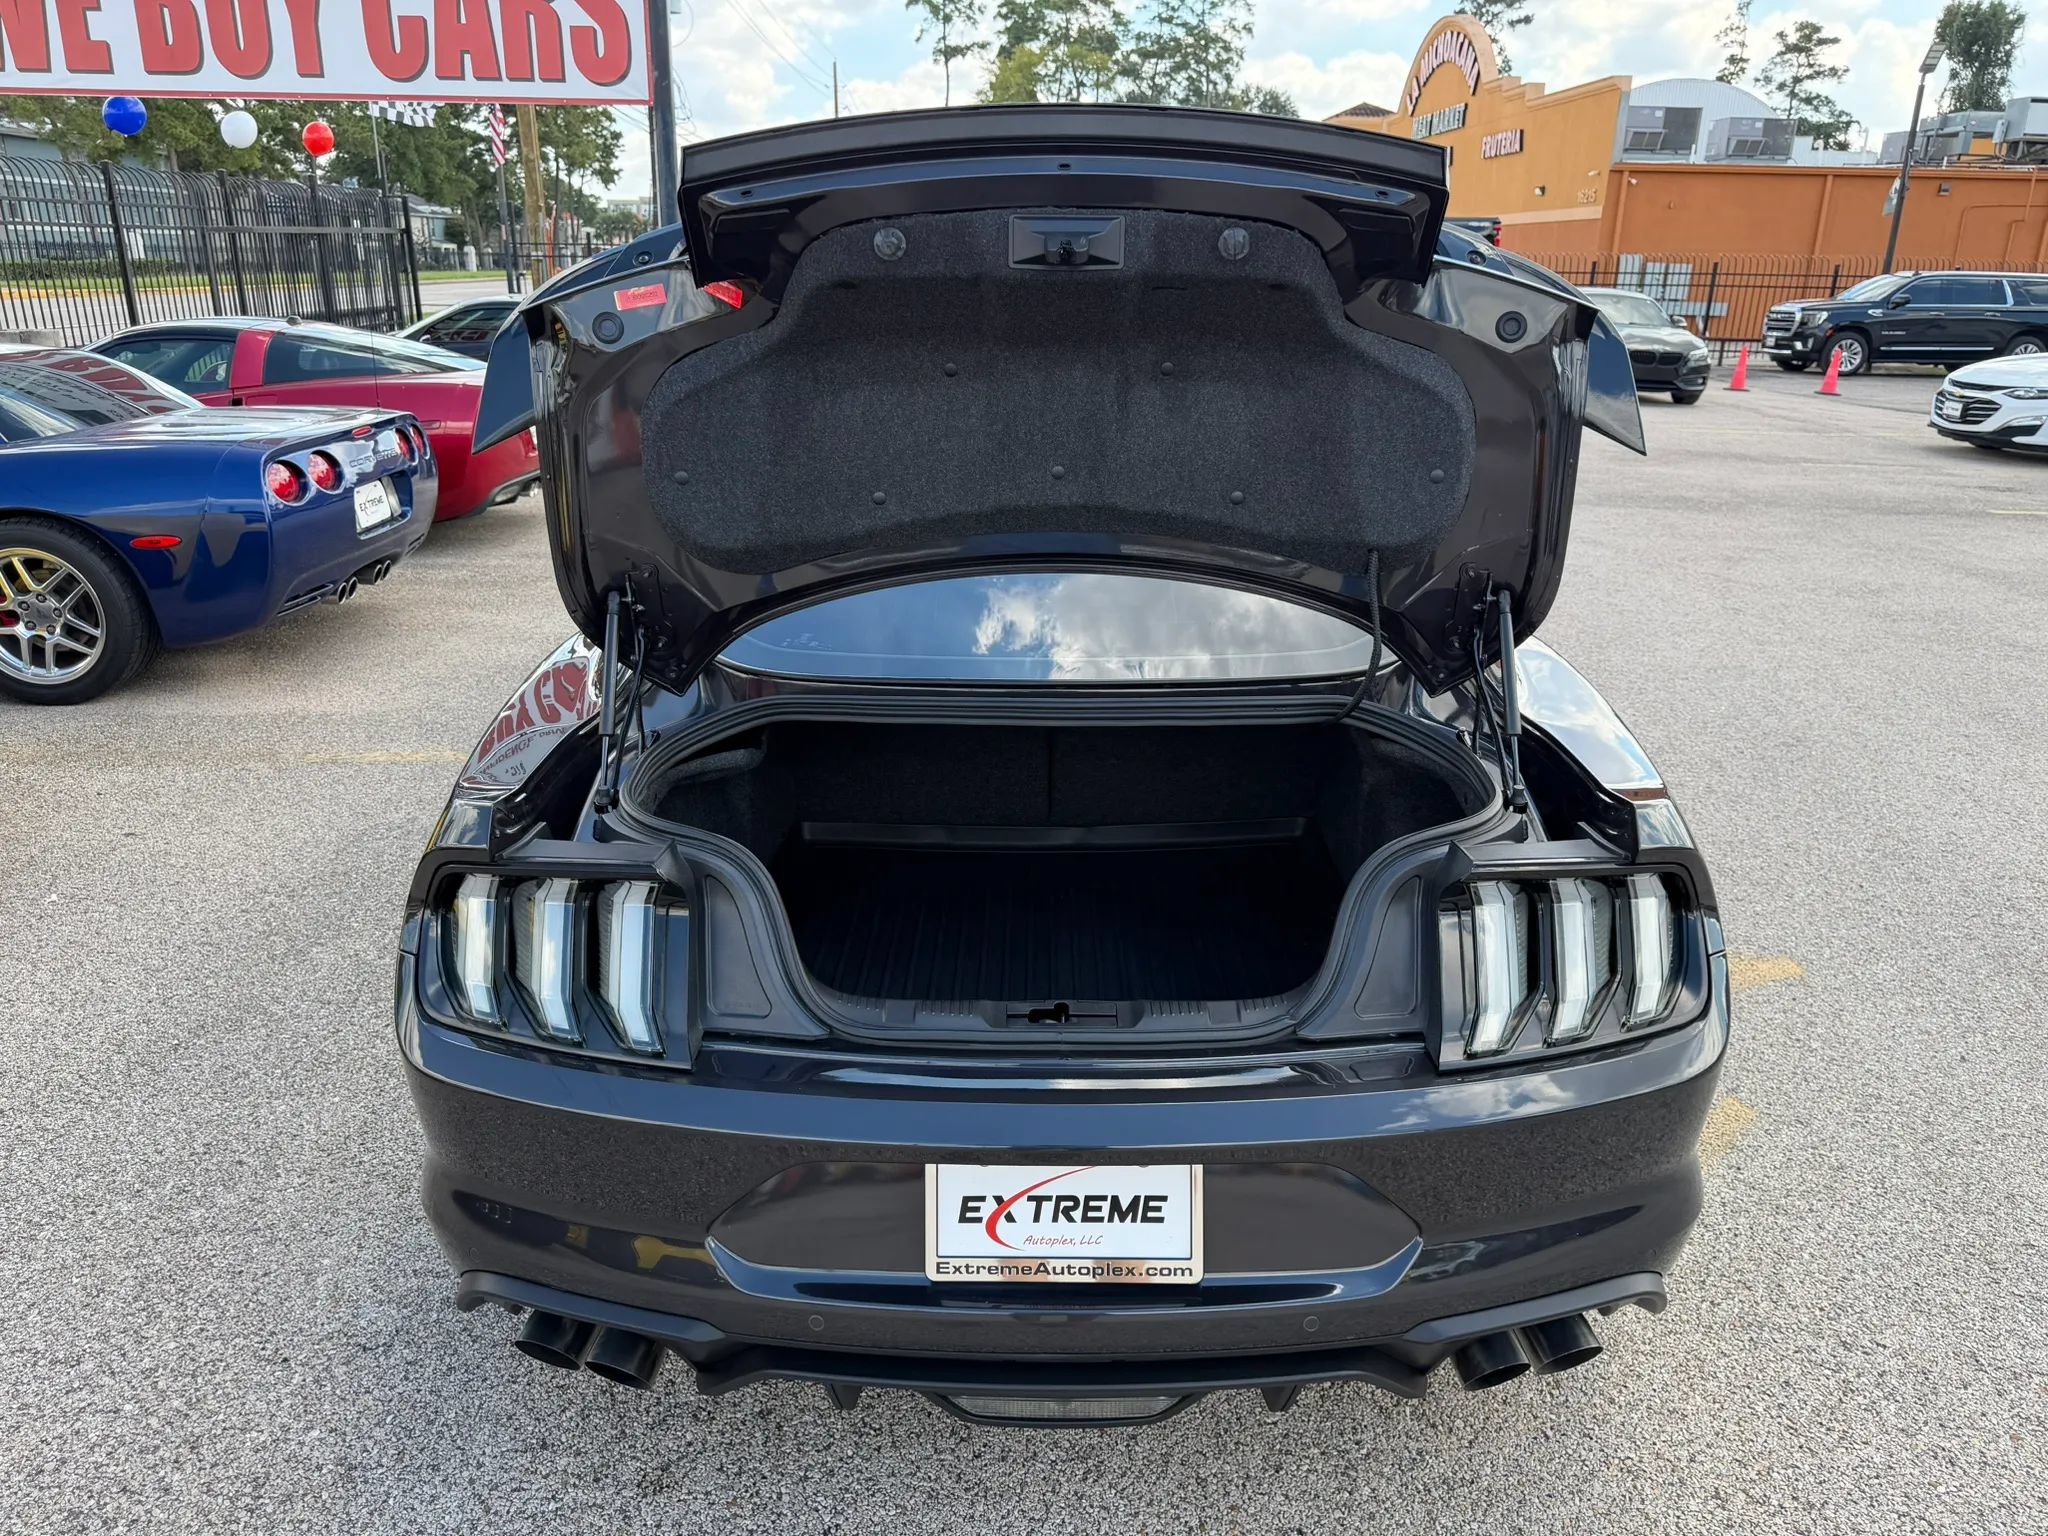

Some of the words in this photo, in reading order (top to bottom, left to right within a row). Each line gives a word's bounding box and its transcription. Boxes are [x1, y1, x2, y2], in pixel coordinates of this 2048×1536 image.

[1406, 75, 1421, 117] LA
[1420, 30, 1480, 96] MICHOACANA
[1430, 103, 1467, 136] MARKET
[1481, 128, 1523, 160] FRUTERIA
[349, 448, 399, 468] CORVETTE
[957, 1194, 1169, 1225] EXTREME
[1023, 1234, 1077, 1248] Autoplex,
[1079, 1234, 1104, 1246] LLC
[935, 1261, 1194, 1279] ExtremeAutoplex.com
